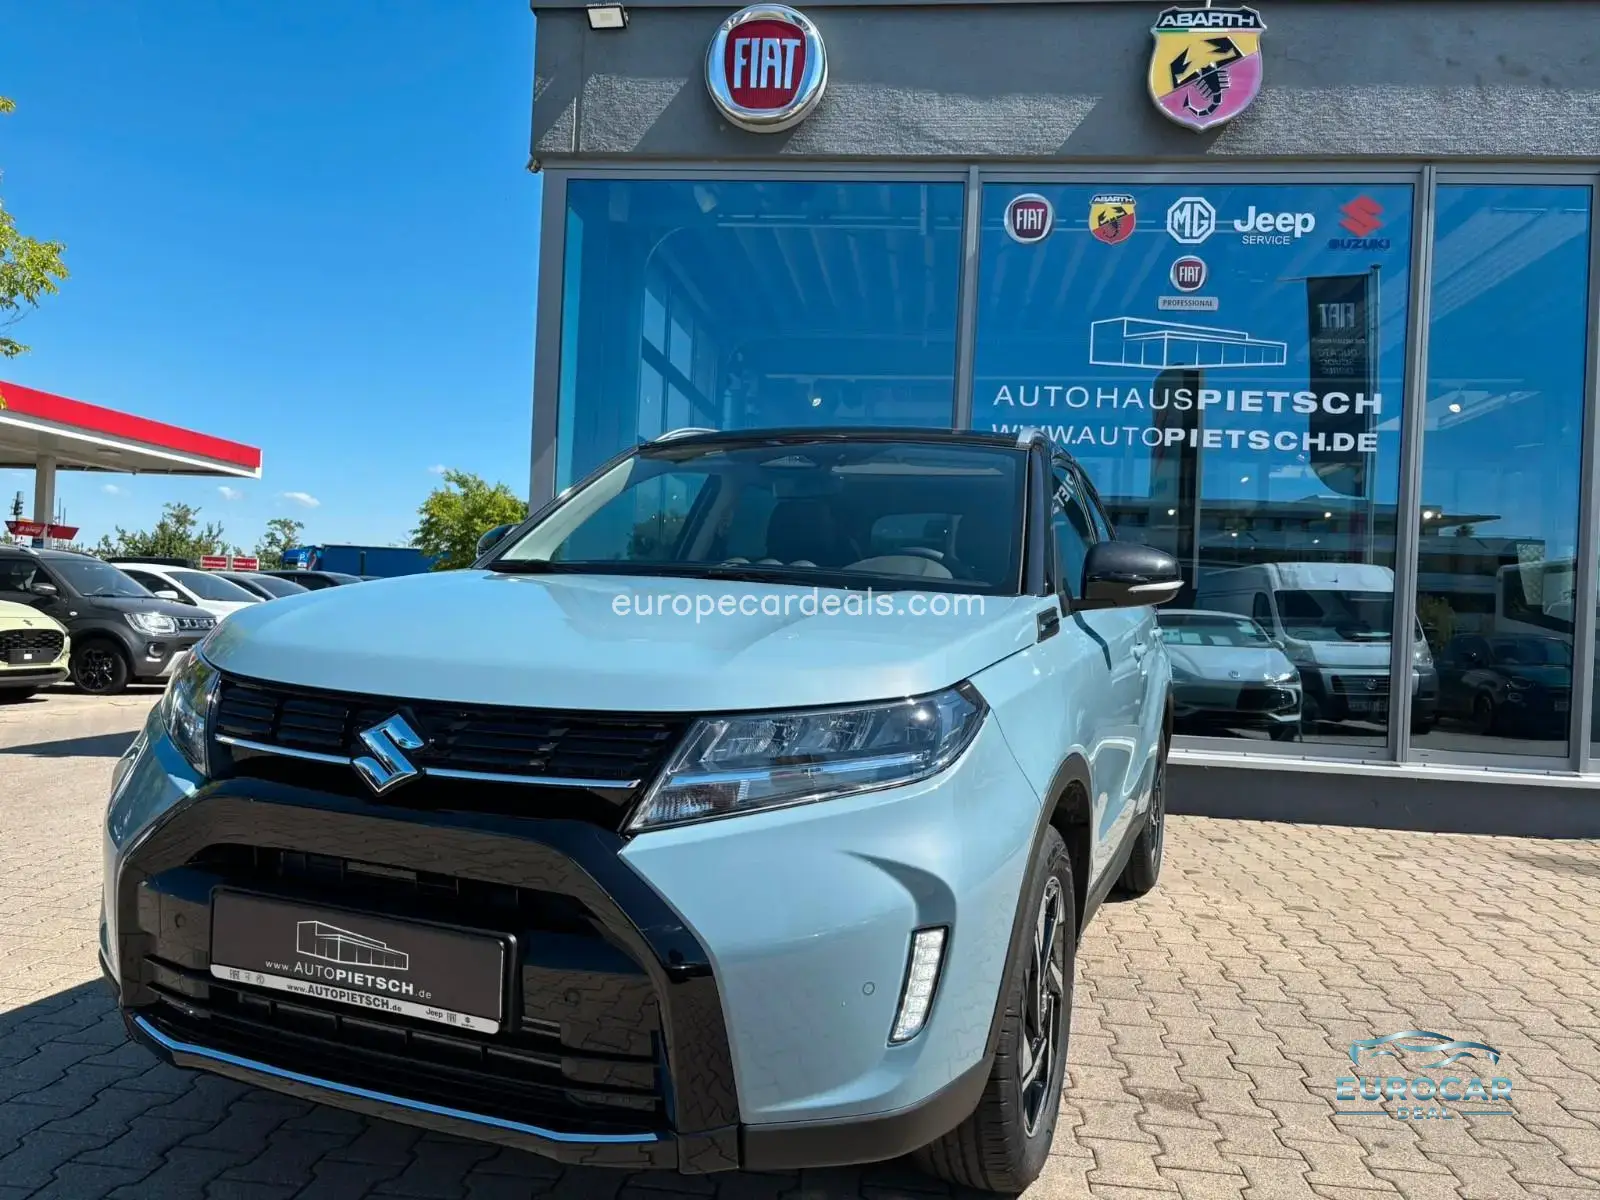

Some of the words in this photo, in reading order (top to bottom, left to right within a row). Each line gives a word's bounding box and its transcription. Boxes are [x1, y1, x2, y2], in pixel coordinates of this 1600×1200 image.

[1159, 10, 1256, 28] ABARTH
[733, 37, 801, 91] FIAT
[1016, 208, 1045, 230] FIAT
[1173, 203, 1209, 237] MG
[1234, 205, 1316, 238] Jeep
[1242, 235, 1291, 245] SERVICE
[1179, 266, 1200, 282] FIAT
[1162, 299, 1213, 307] PROFESSIONAL
[992, 385, 1382, 415] AUTOHAUSPIETSCH
